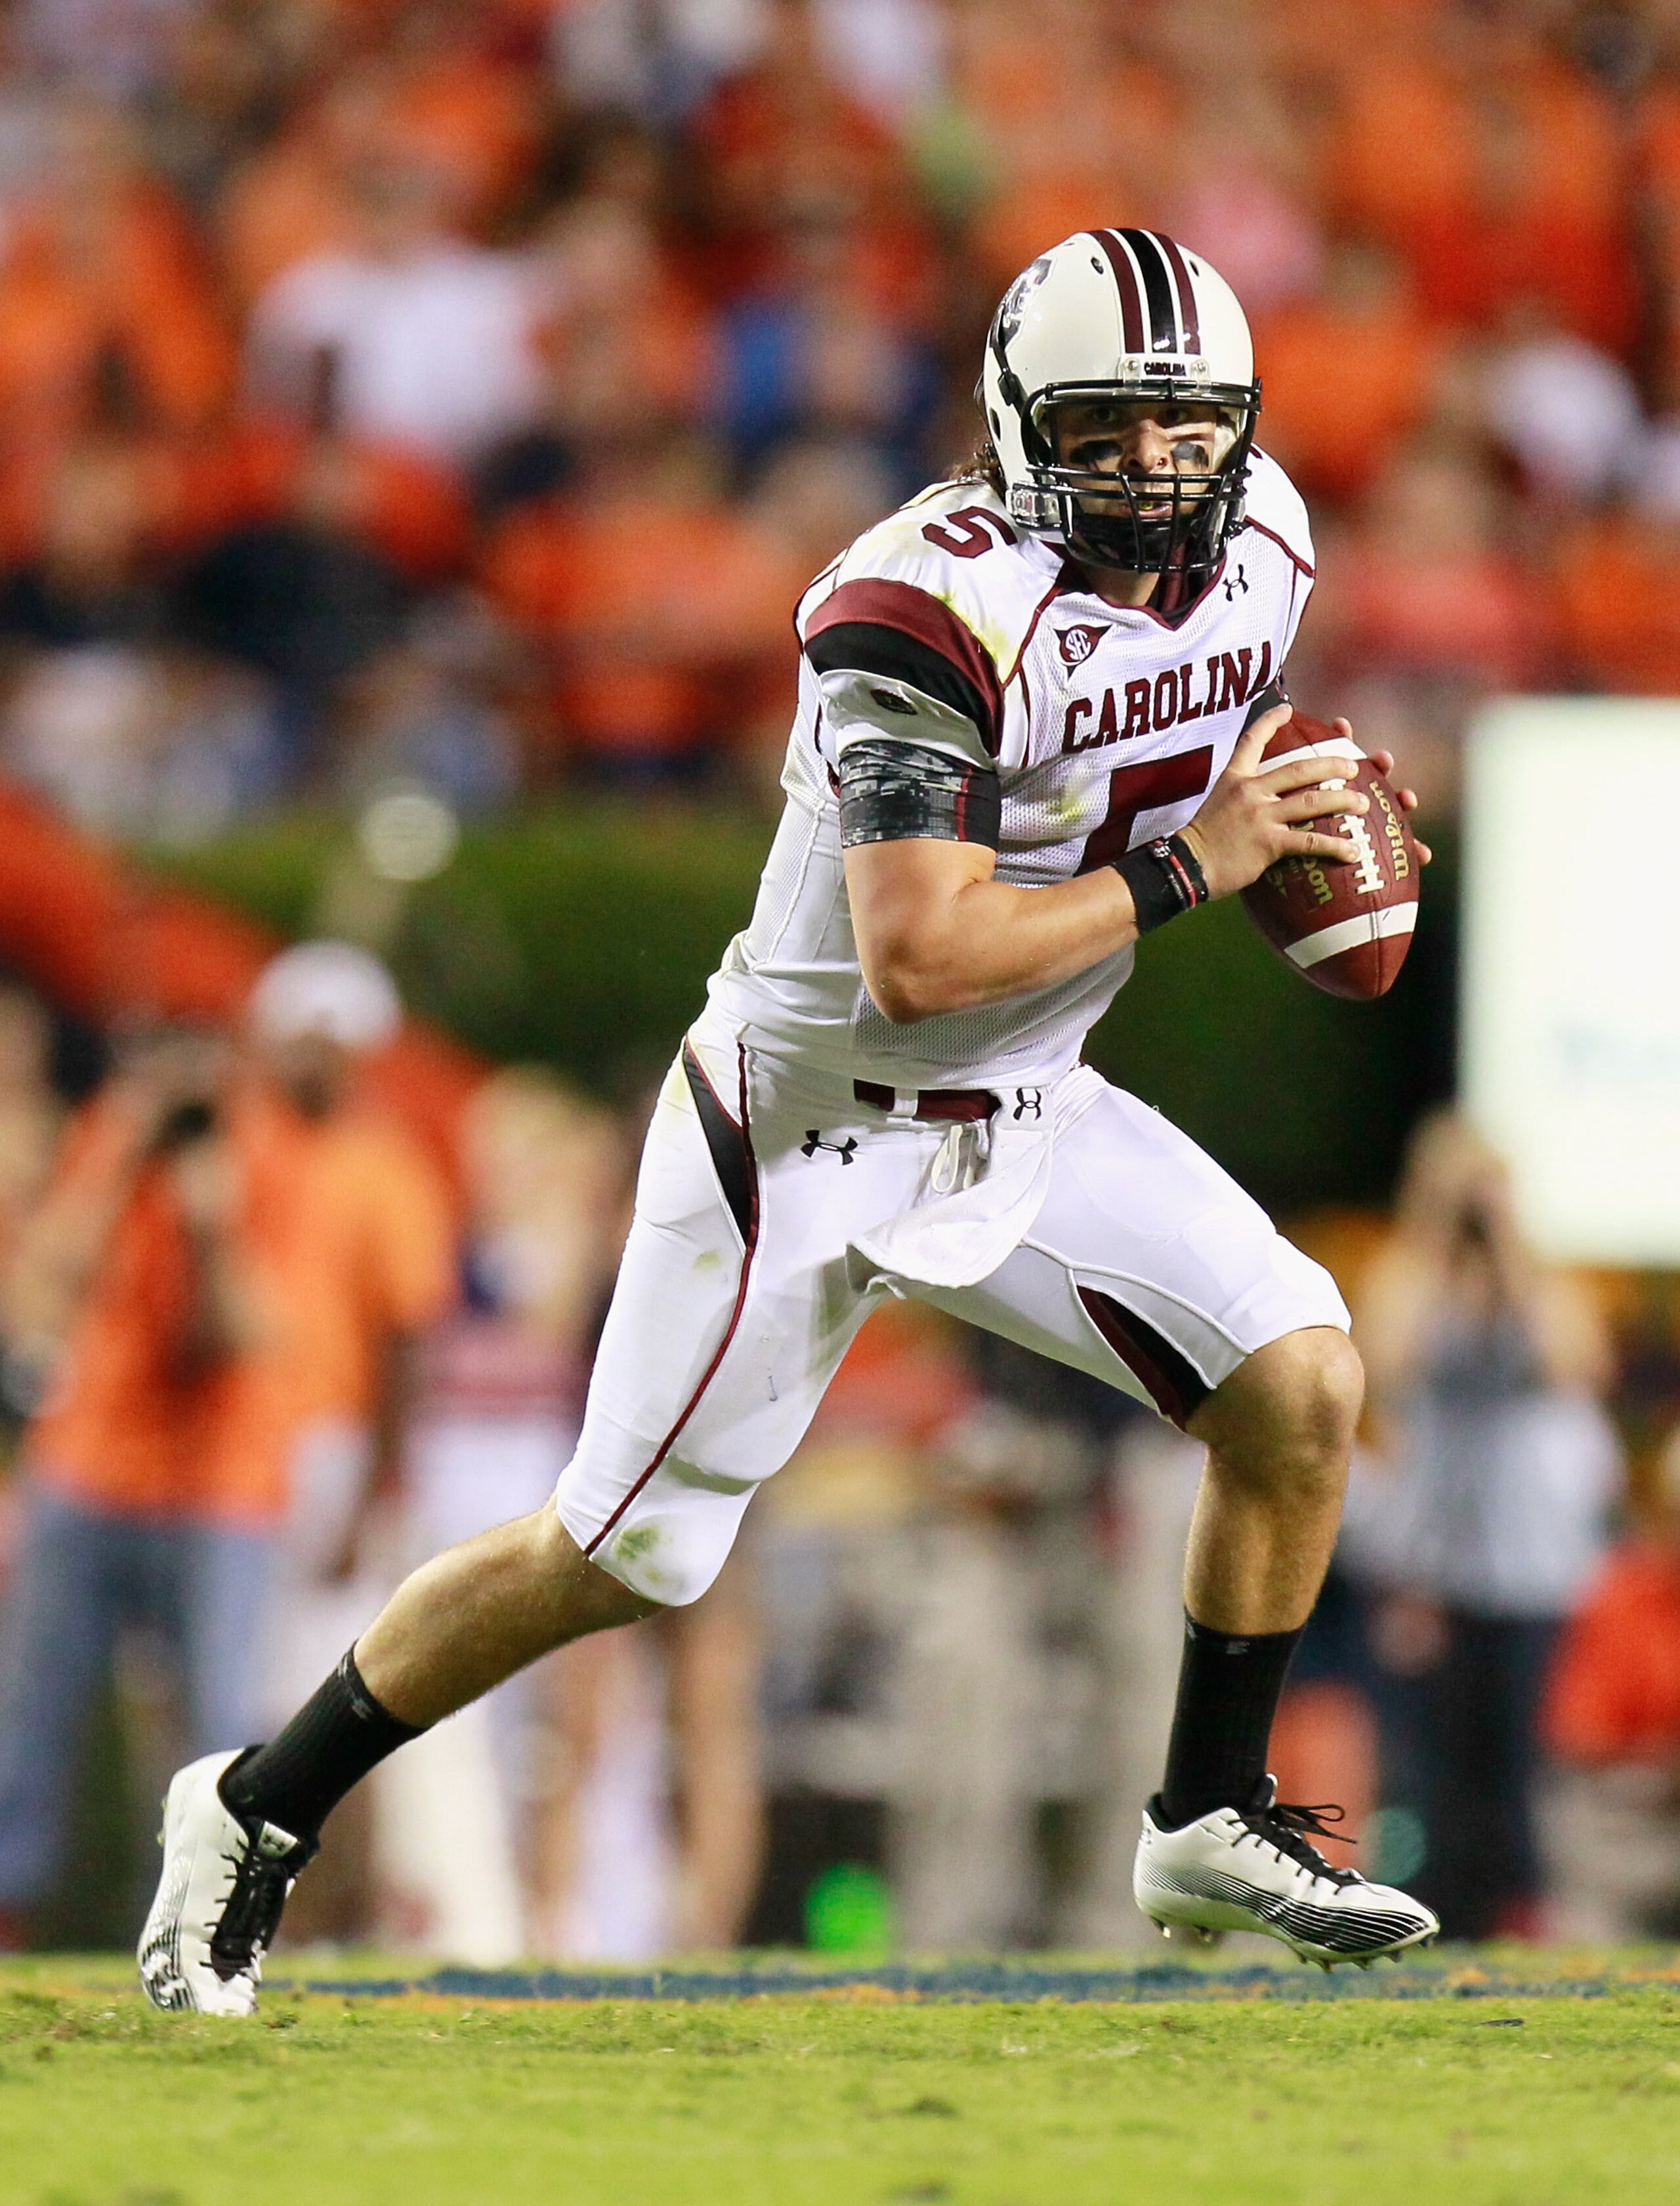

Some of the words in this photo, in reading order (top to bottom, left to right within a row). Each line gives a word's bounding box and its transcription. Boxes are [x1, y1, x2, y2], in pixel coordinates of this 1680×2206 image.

[921, 505, 1018, 559] 5
[1065, 628, 1092, 661] SEC
[1369, 779, 1410, 881] Wilson
